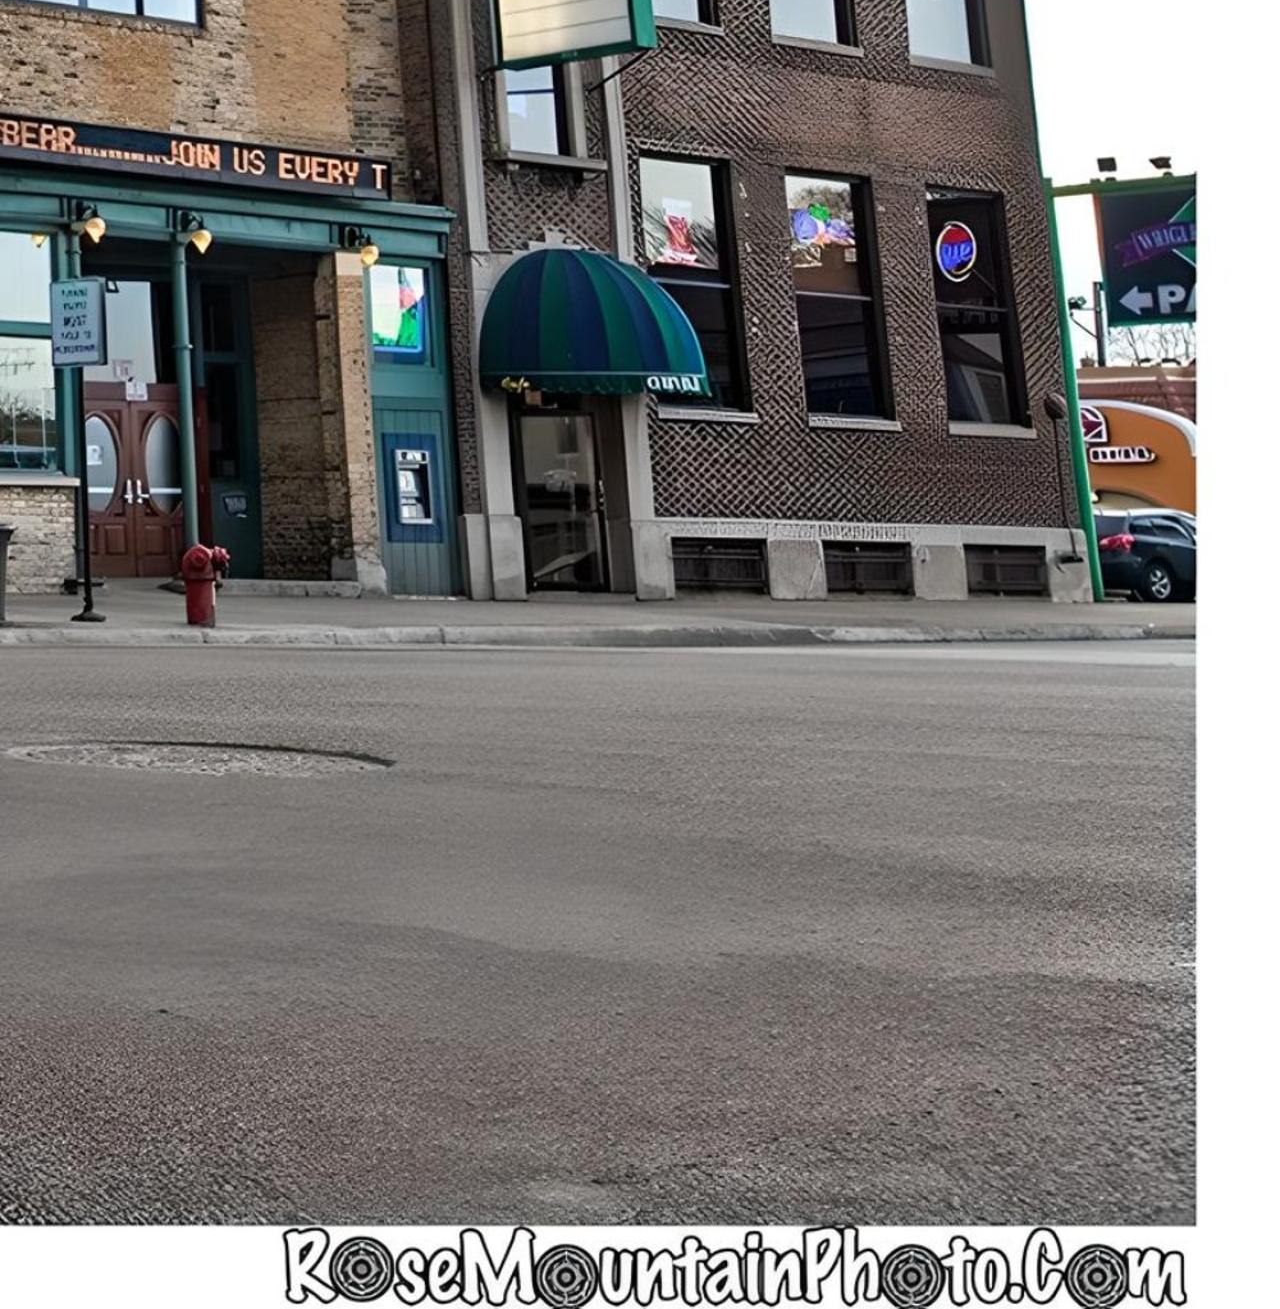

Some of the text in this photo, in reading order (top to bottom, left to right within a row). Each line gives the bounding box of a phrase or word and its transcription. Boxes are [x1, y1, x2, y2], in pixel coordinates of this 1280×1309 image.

[233, 147, 266, 175] US
[278, 152, 360, 185] EVERY
[371, 164, 388, 190] T
